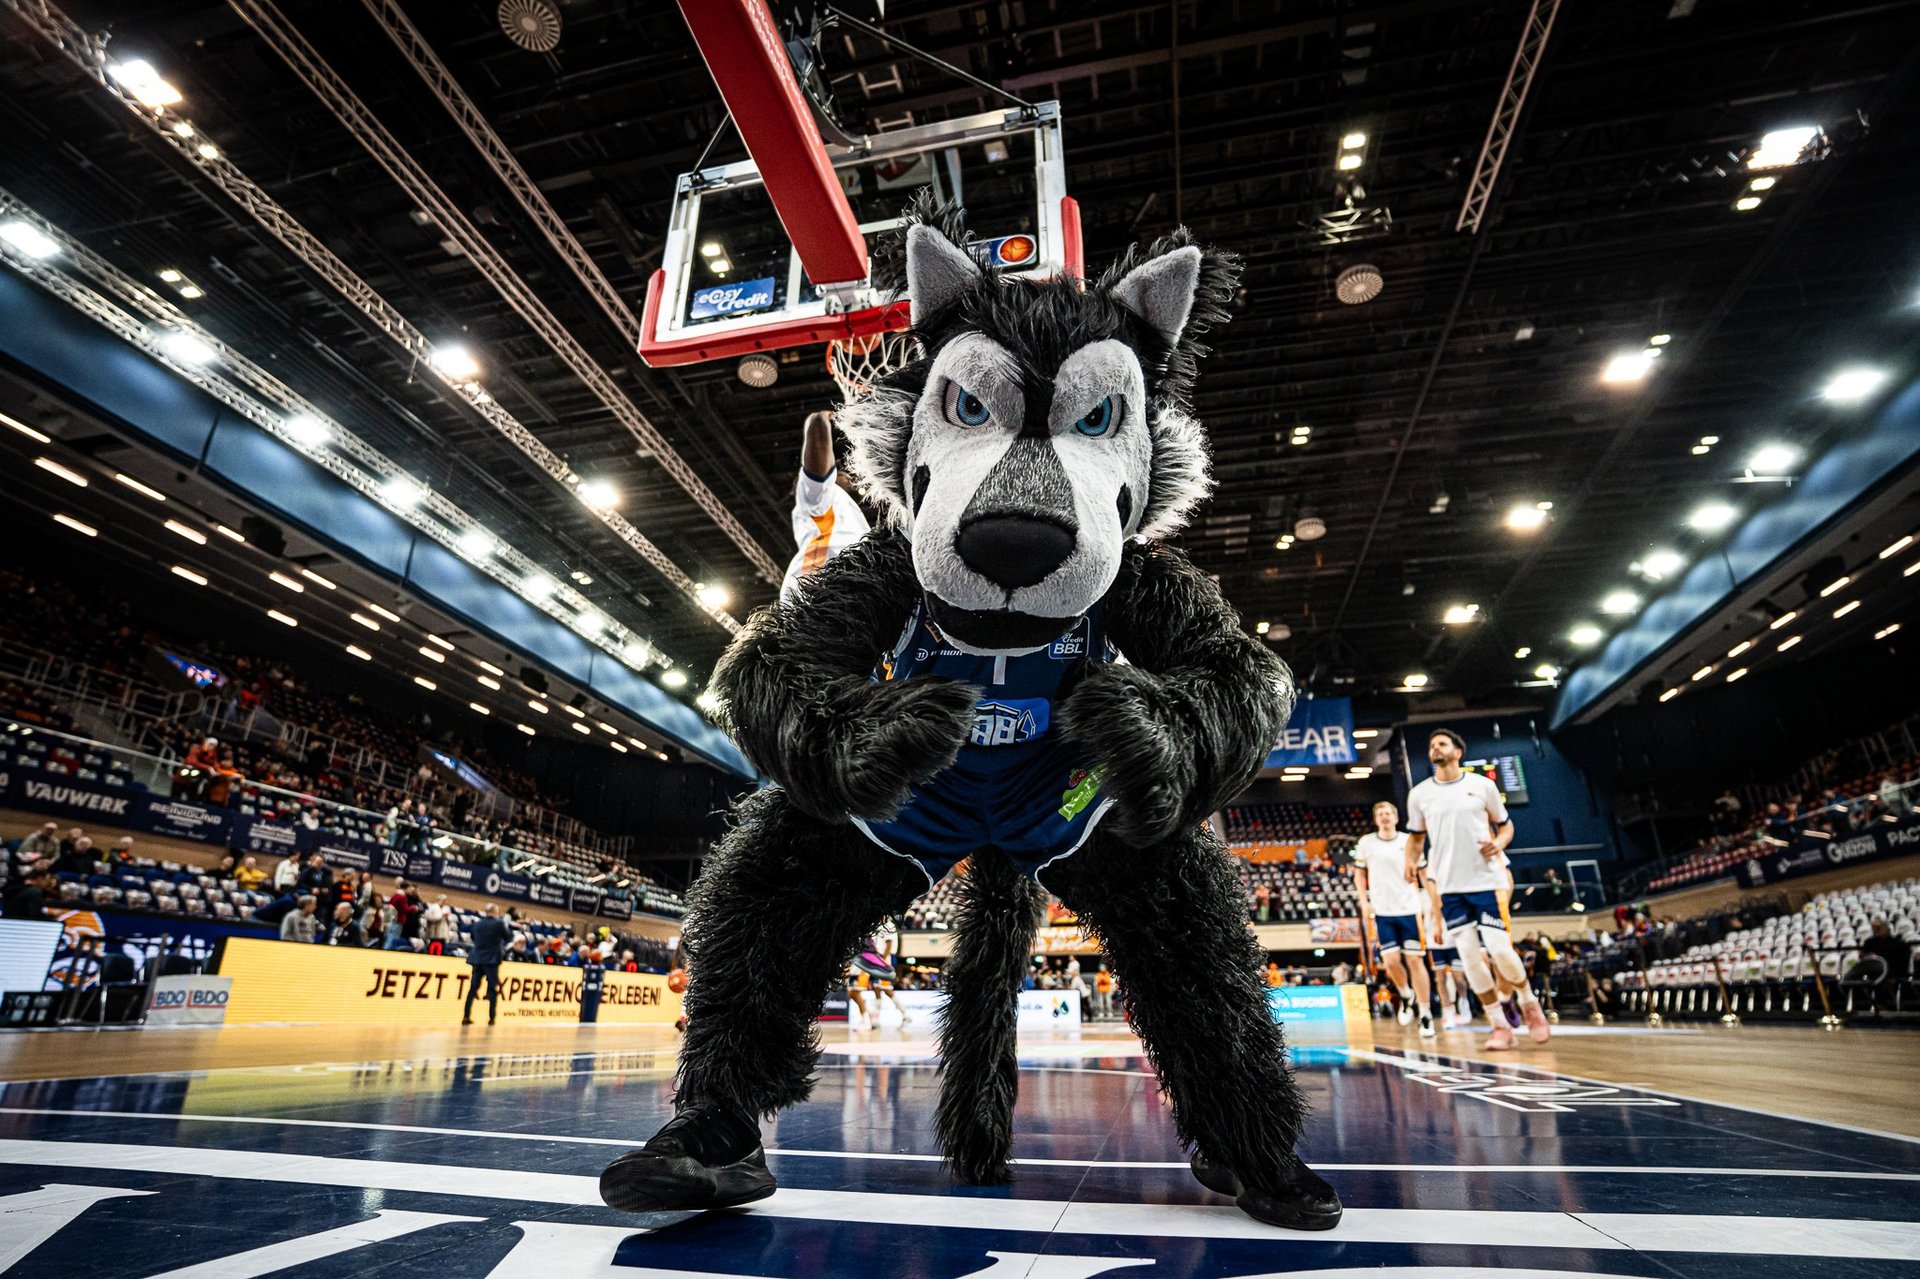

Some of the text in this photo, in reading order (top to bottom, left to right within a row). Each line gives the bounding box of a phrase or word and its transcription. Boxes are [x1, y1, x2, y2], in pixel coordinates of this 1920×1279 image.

[717, 292, 769, 312] Credit
[1053, 643, 1083, 654] BBL
[25, 780, 129, 815] VAUWERK
[383, 848, 408, 869] TSS
[366, 968, 449, 1000] JETZT
[156, 990, 187, 1006] BDO
[193, 989, 229, 1004] BDO
